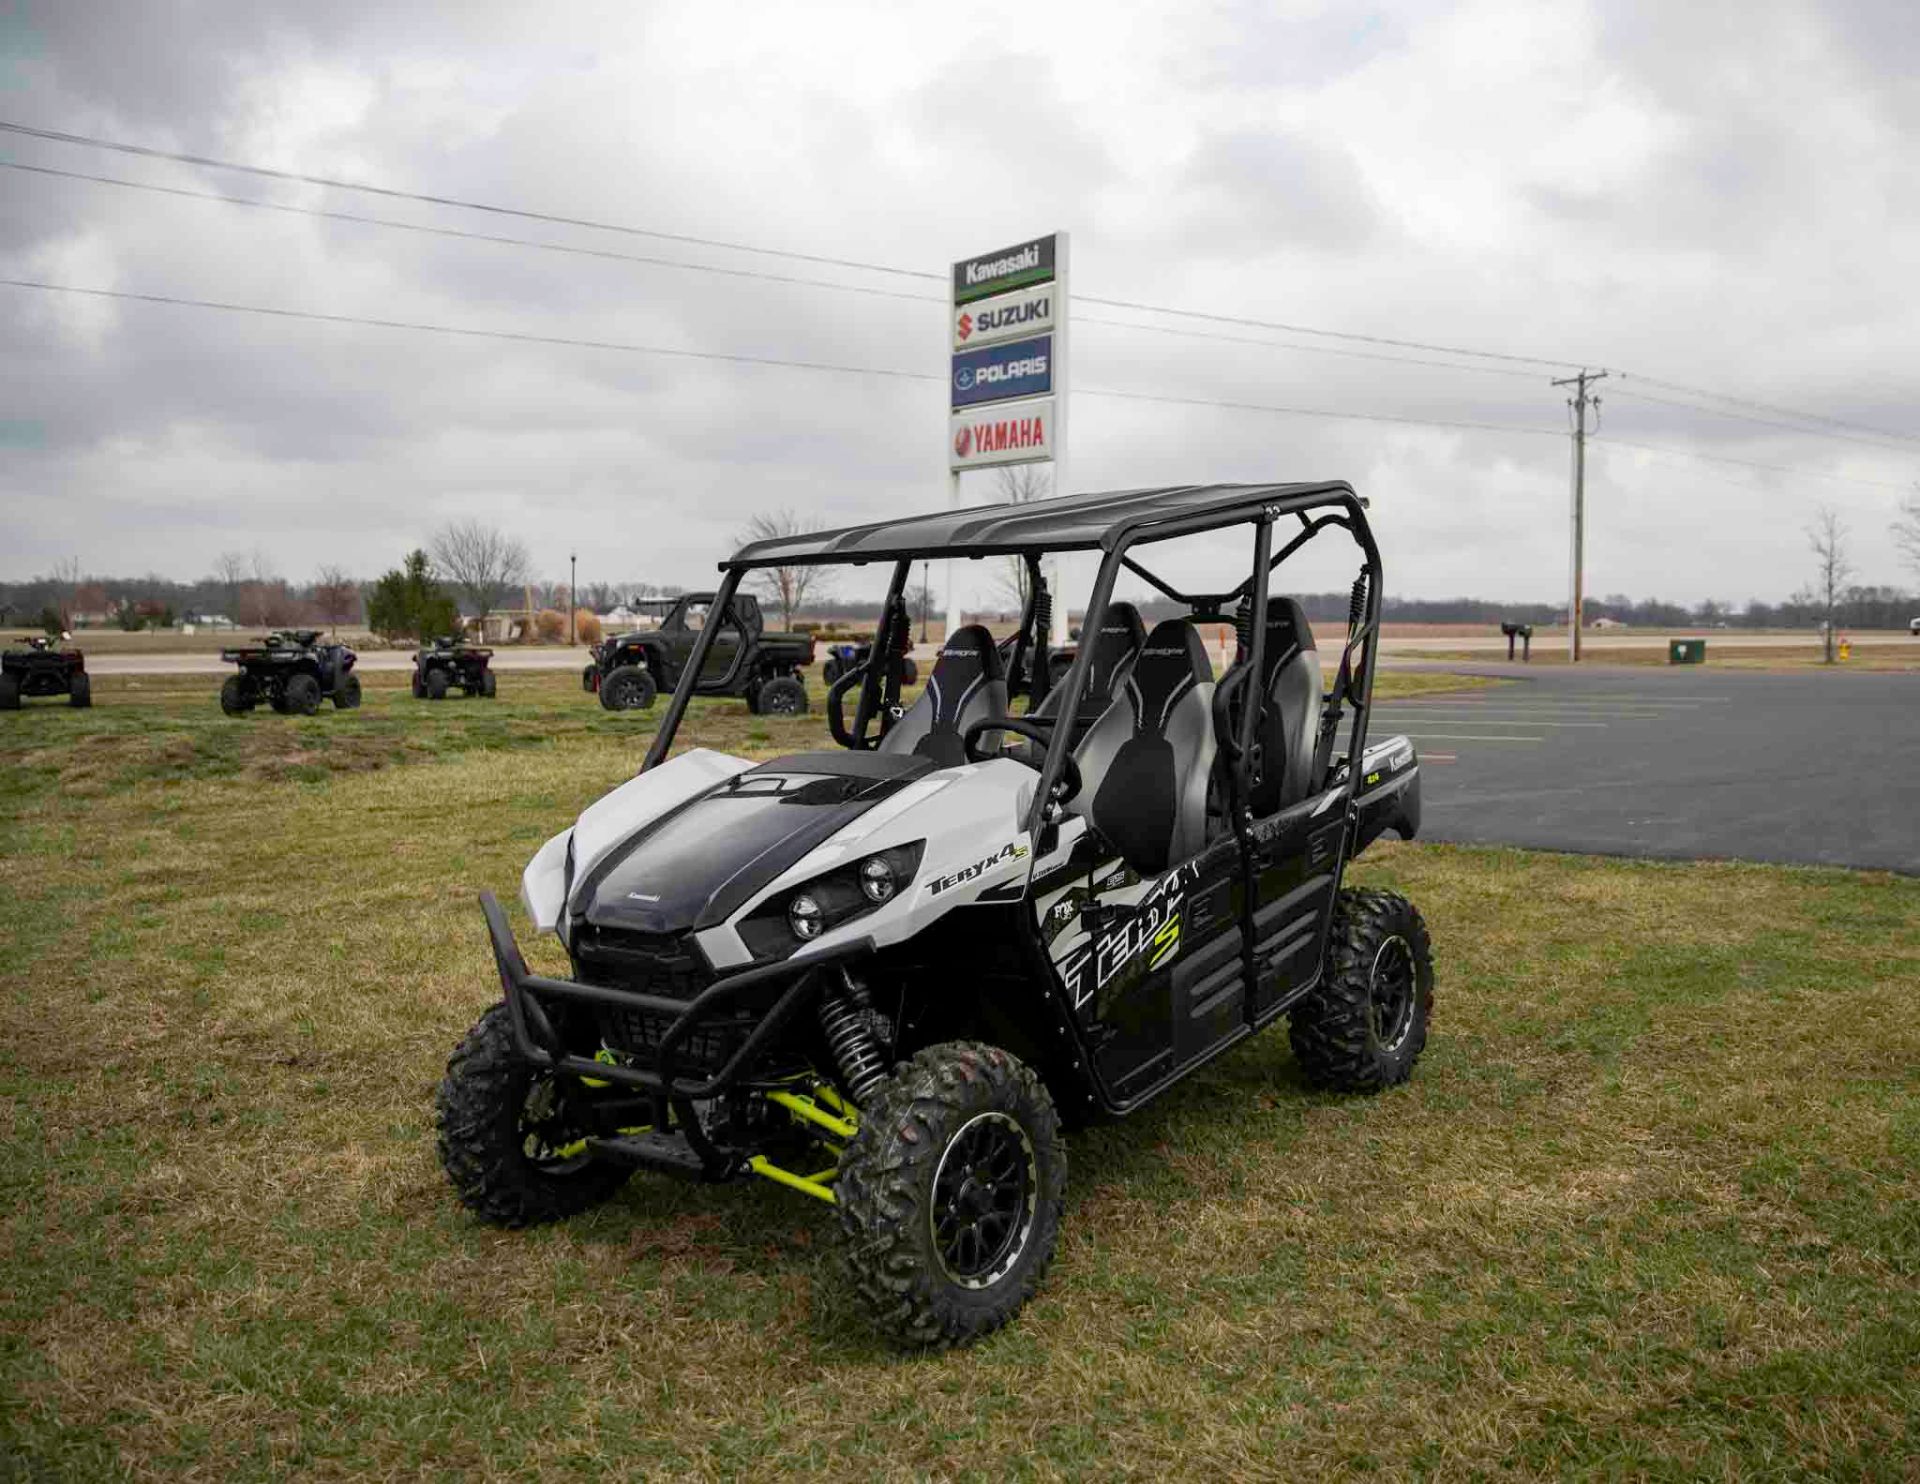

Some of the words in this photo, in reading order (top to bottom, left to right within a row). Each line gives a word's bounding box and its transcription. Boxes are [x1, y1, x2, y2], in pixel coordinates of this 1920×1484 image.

[966, 244, 1040, 285] Kawasaki
[977, 298, 1049, 332] SUZUKI
[976, 356, 1047, 385] POLARIS
[974, 416, 1044, 453] YAMAHA
[1054, 899, 1075, 920] FOX
